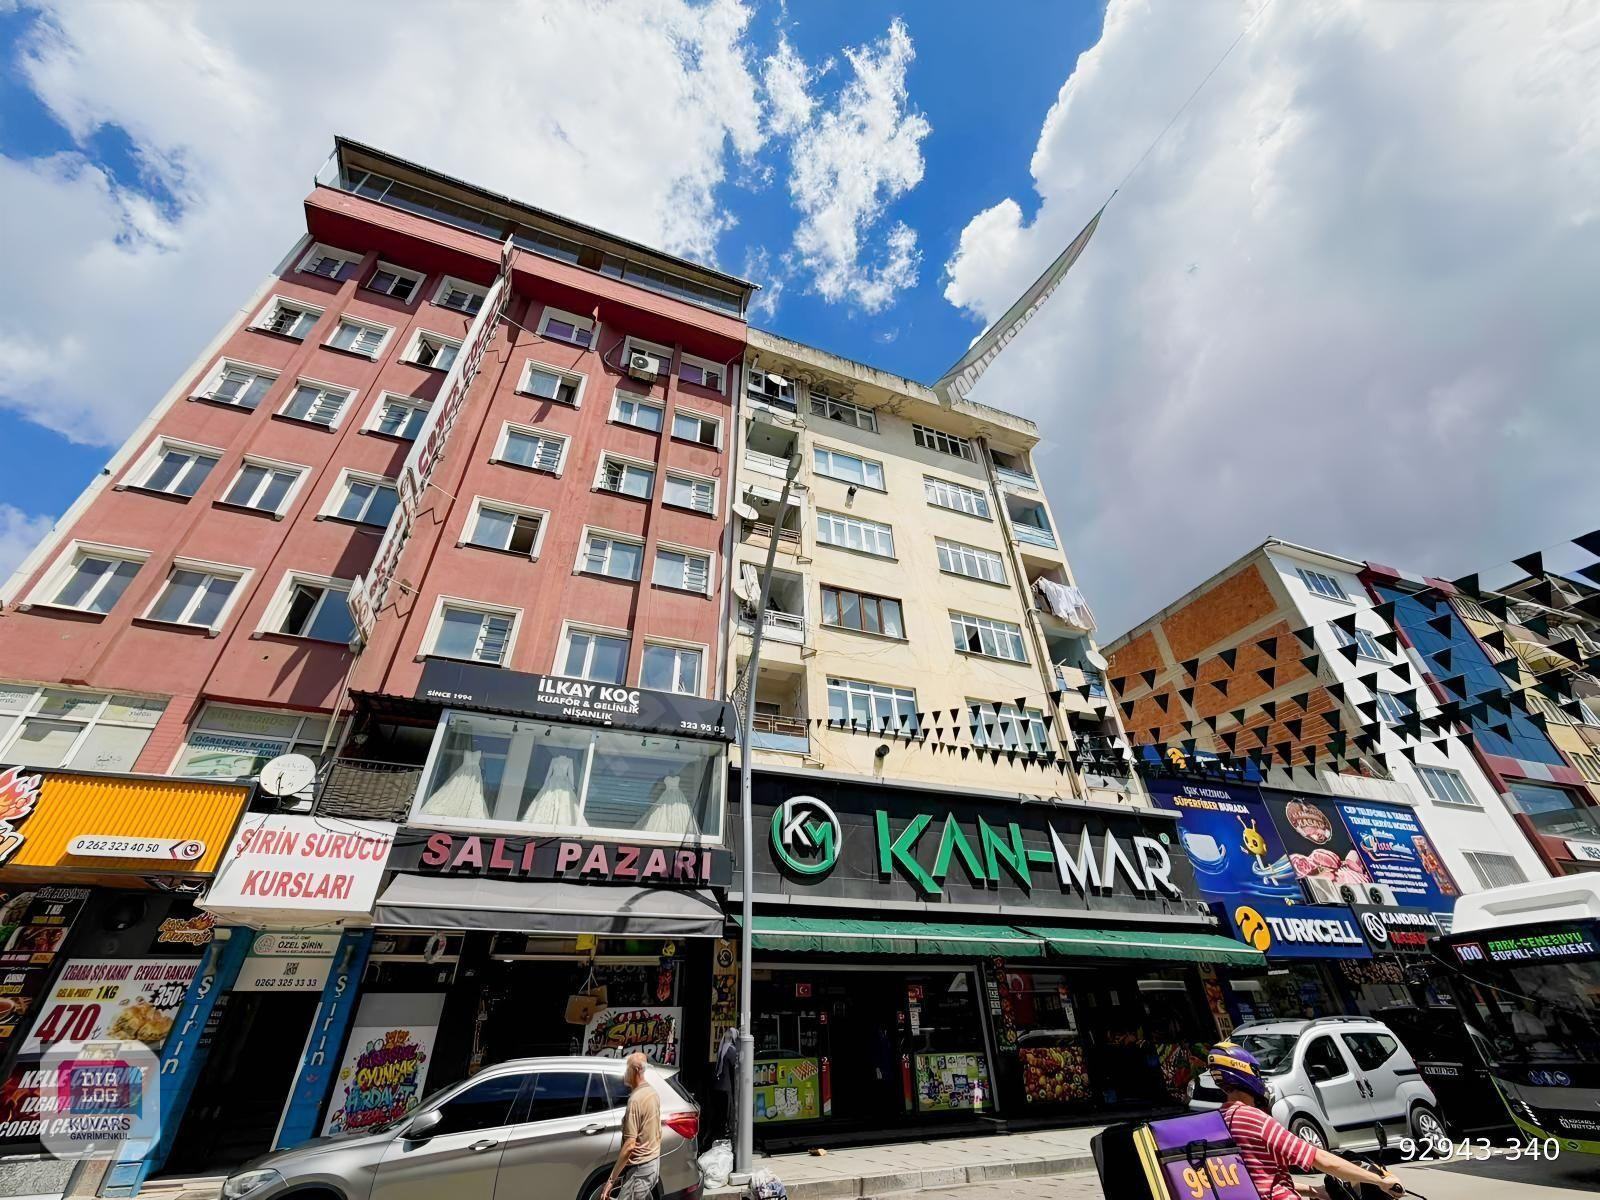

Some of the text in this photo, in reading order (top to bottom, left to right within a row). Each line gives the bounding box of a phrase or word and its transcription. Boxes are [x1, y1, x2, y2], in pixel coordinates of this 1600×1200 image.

[537, 674, 640, 708] İLKAY KOÇ
[537, 694, 640, 716] KUAFÖR & GELİNLİK
[680, 720, 699, 730] 323
[700, 723, 713, 732] 95
[76, 840, 160, 853] 0 262 323 40 50
[236, 823, 390, 862] ŞİRİN SÜRÜCÜ
[875, 809, 1184, 895] KAN-MAR
[556, 841, 712, 880] PAZARI
[240, 869, 356, 901] KURSLARI
[1266, 915, 1364, 944] TURKCELL
[1456, 945, 1483, 961] 100
[61, 964, 91, 981] IZGARA
[103, 964, 134, 981] KANAT
[102, 985, 120, 999] KG
[1182, 1156, 1241, 1198] getir
